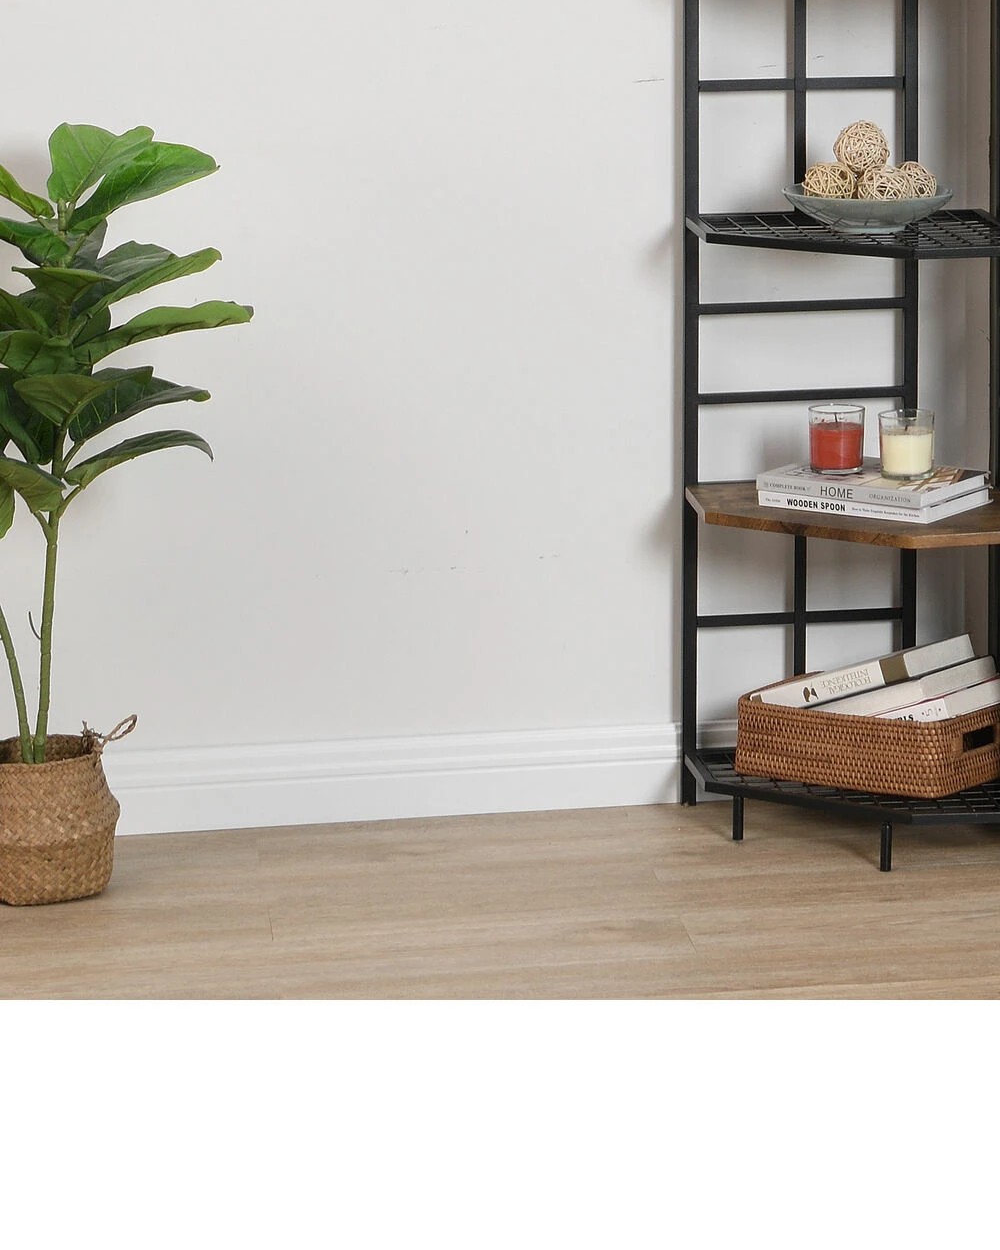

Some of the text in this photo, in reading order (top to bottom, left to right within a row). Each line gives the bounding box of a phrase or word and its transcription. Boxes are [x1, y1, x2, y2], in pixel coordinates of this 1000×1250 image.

[820, 485, 853, 499] HOME
[868, 493, 911, 503] ORGANIZATION
[786, 498, 818, 509] WOODEN
[820, 502, 846, 512] SPOON
